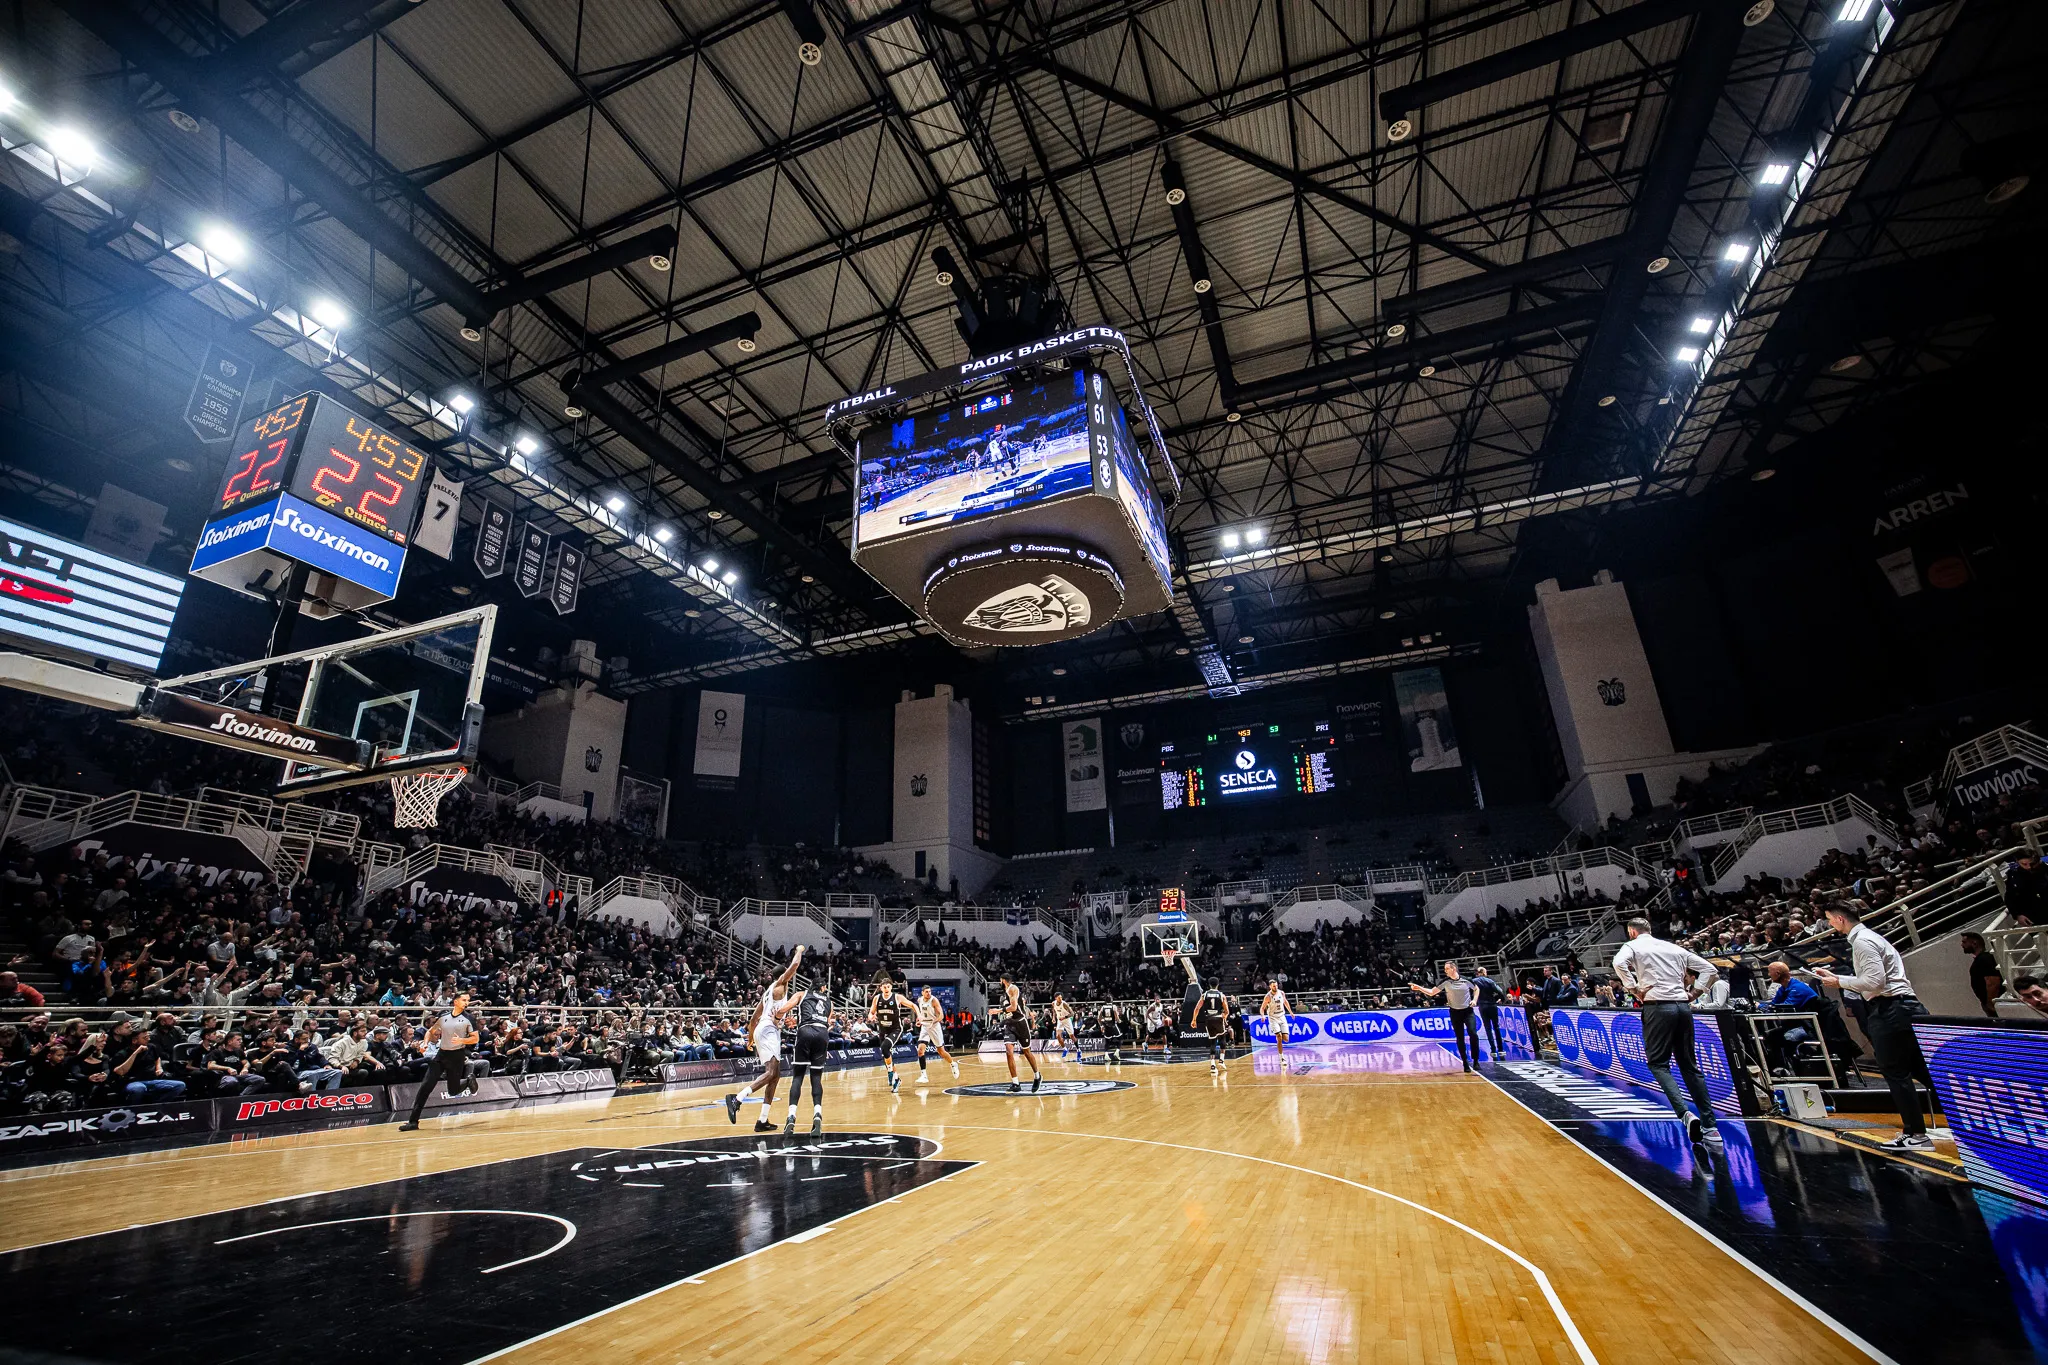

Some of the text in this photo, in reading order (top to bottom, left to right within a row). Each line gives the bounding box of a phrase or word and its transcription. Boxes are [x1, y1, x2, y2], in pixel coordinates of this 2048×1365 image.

[960, 327, 1129, 374] PAOK BASKETBA
[203, 398, 228, 416] 1959
[1094, 403, 1105, 425] 61
[192, 414, 227, 435] CHAMPION
[201, 411, 223, 426] GREEK
[345, 417, 424, 481] 4:53
[1096, 434, 1109, 456] 53
[222, 438, 288, 501] 22
[311, 448, 404, 524] 22
[344, 506, 387, 532] Quince
[433, 499, 450, 522] 7
[199, 512, 271, 550] Stoiximan
[274, 508, 392, 573] Stoiximan
[484, 543, 499, 556] 1994
[960, 549, 1002, 563] Stoiximan
[1026, 544, 1070, 554] Stoiximan
[210, 712, 318, 753] Stoiximan
[1269, 725, 1279, 733] 53
[1117, 767, 1155, 778] Stoiximan
[1220, 769, 1277, 788] SENECA
[1954, 765, 2039, 806] Γιαννίρης
[1160, 898, 1178, 910] 22
[1180, 1031, 1209, 1039] Stoixima
[1331, 1019, 1391, 1035] ΜΕΒΓΑΛ
[524, 1069, 606, 1089] FARCOM
[236, 1092, 374, 1121] mateco
[614, 1135, 899, 1173] Stoiximan
